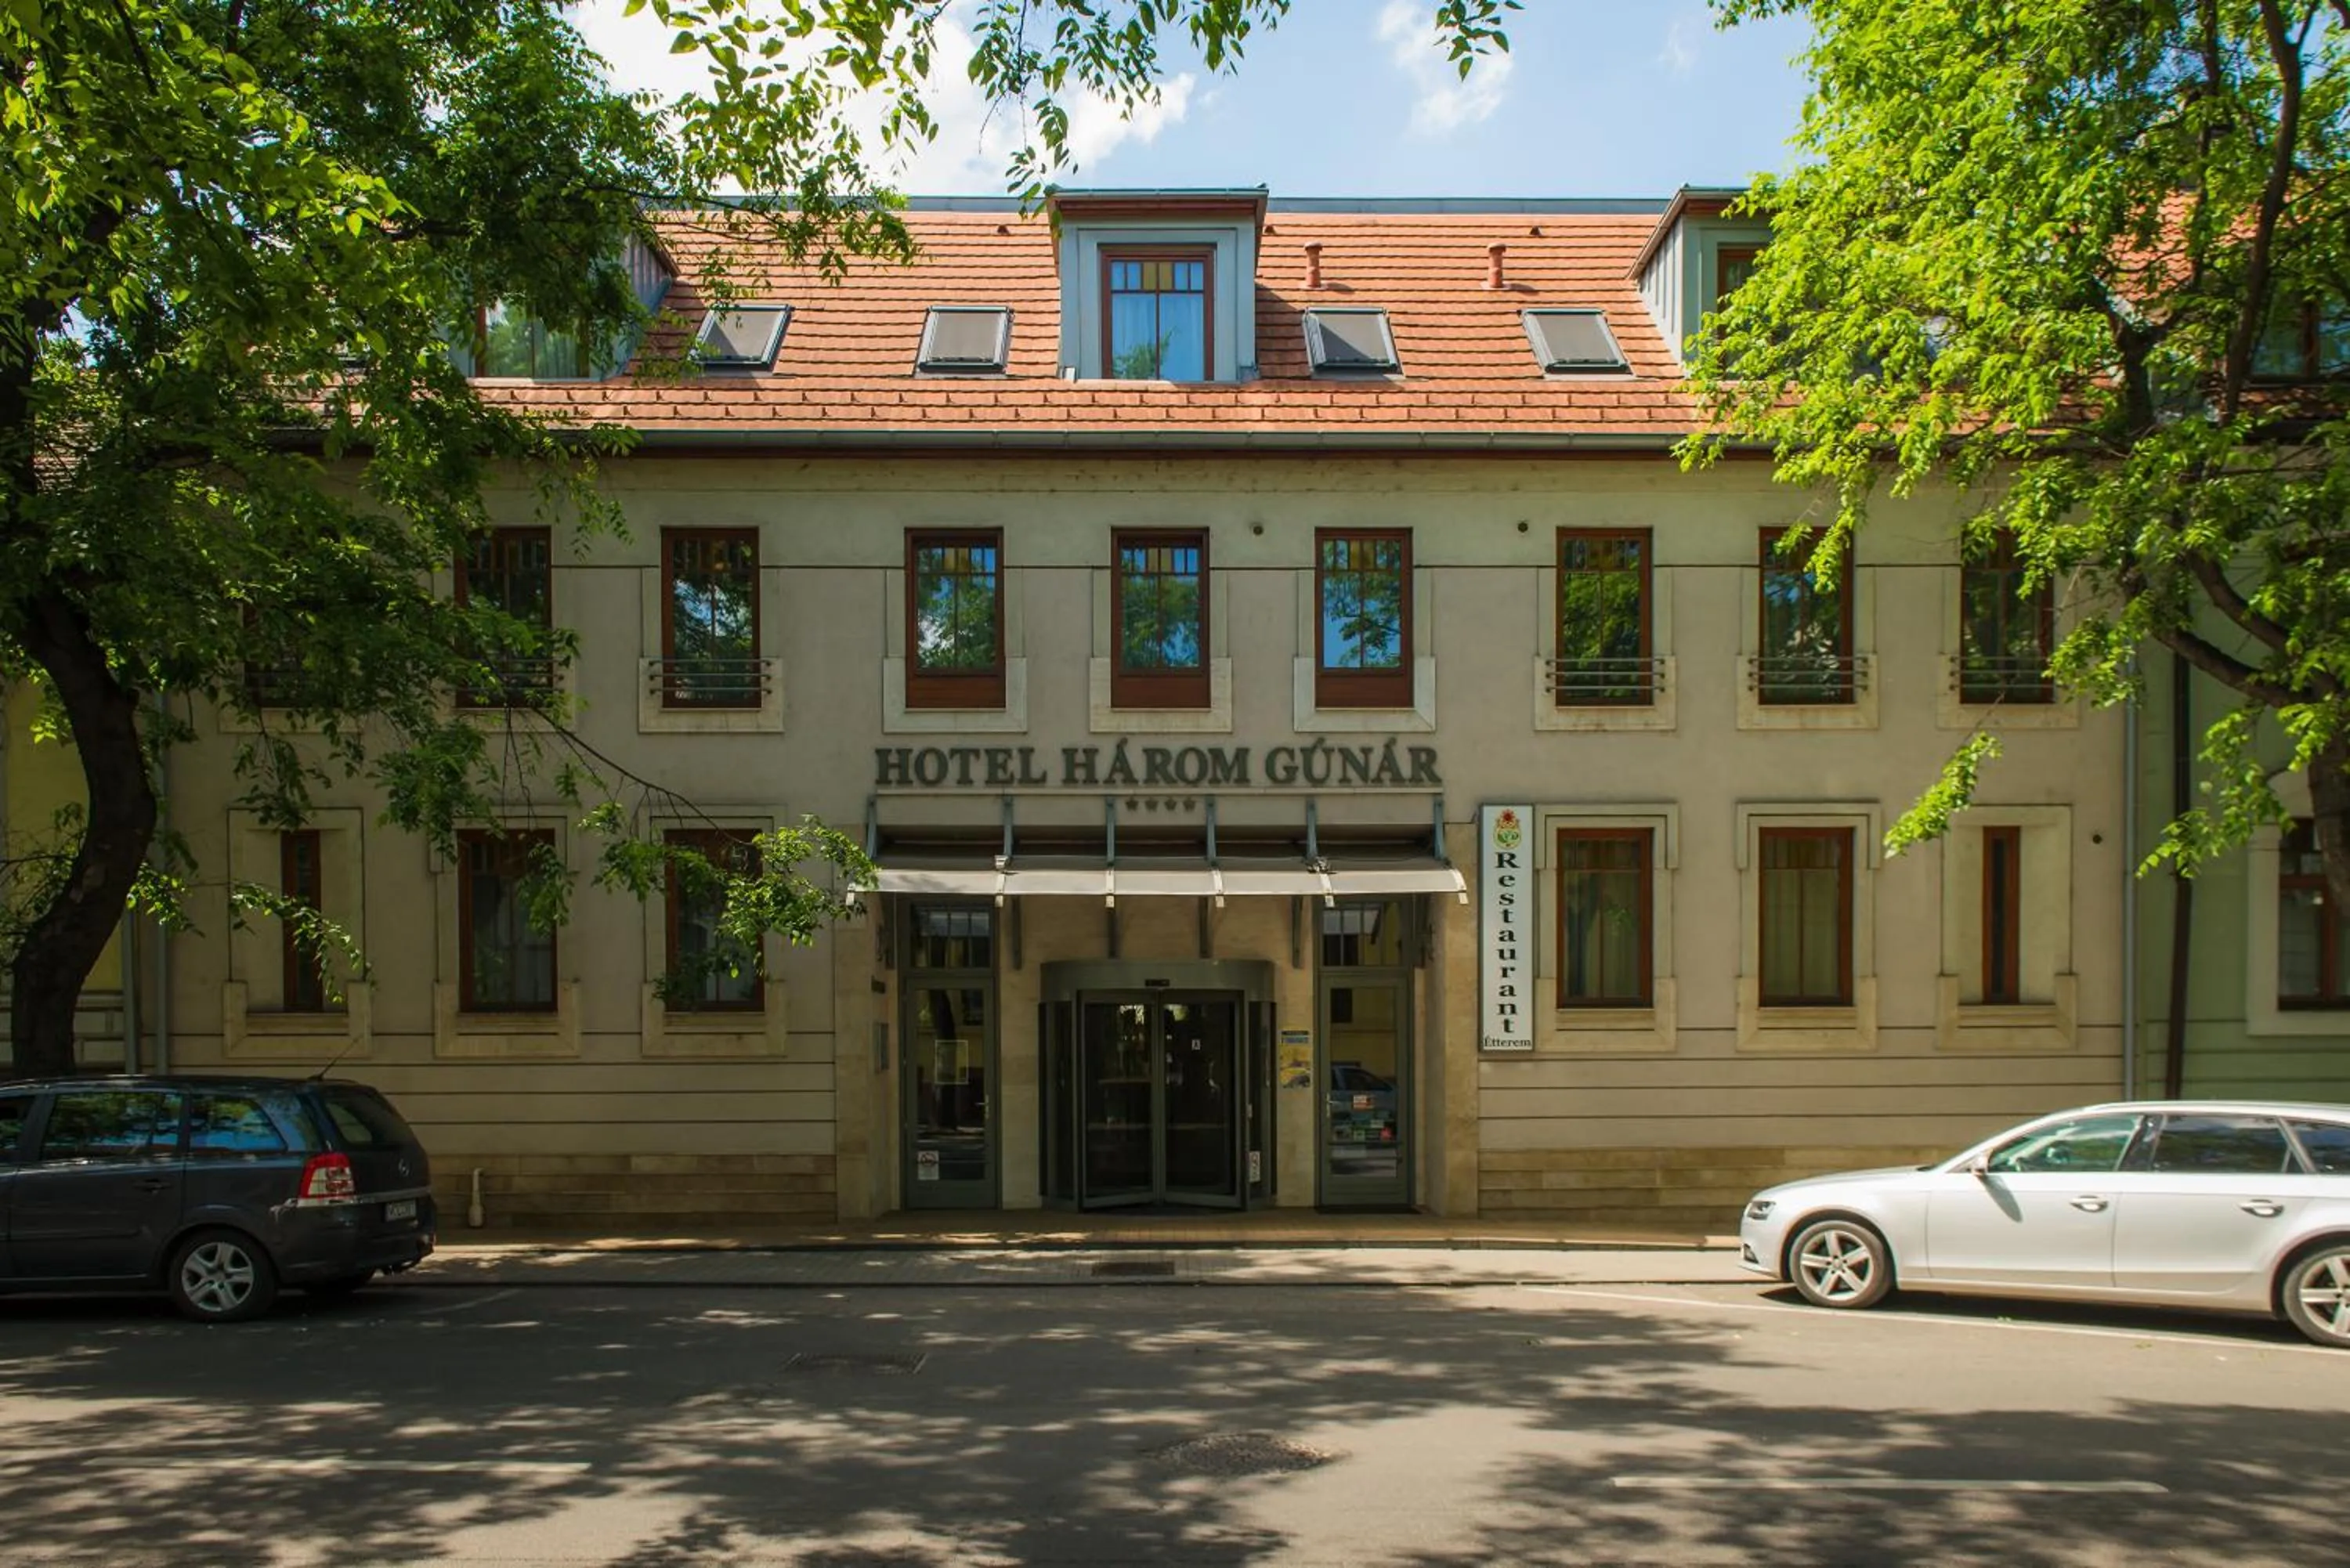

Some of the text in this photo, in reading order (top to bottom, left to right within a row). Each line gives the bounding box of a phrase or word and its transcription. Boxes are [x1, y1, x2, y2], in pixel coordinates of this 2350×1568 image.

[875, 737, 1442, 785] HOTEL HÁROM GÚNÁR
[1495, 851, 1520, 1033] Restaurant
[1484, 1035, 1531, 1047] Étterem
